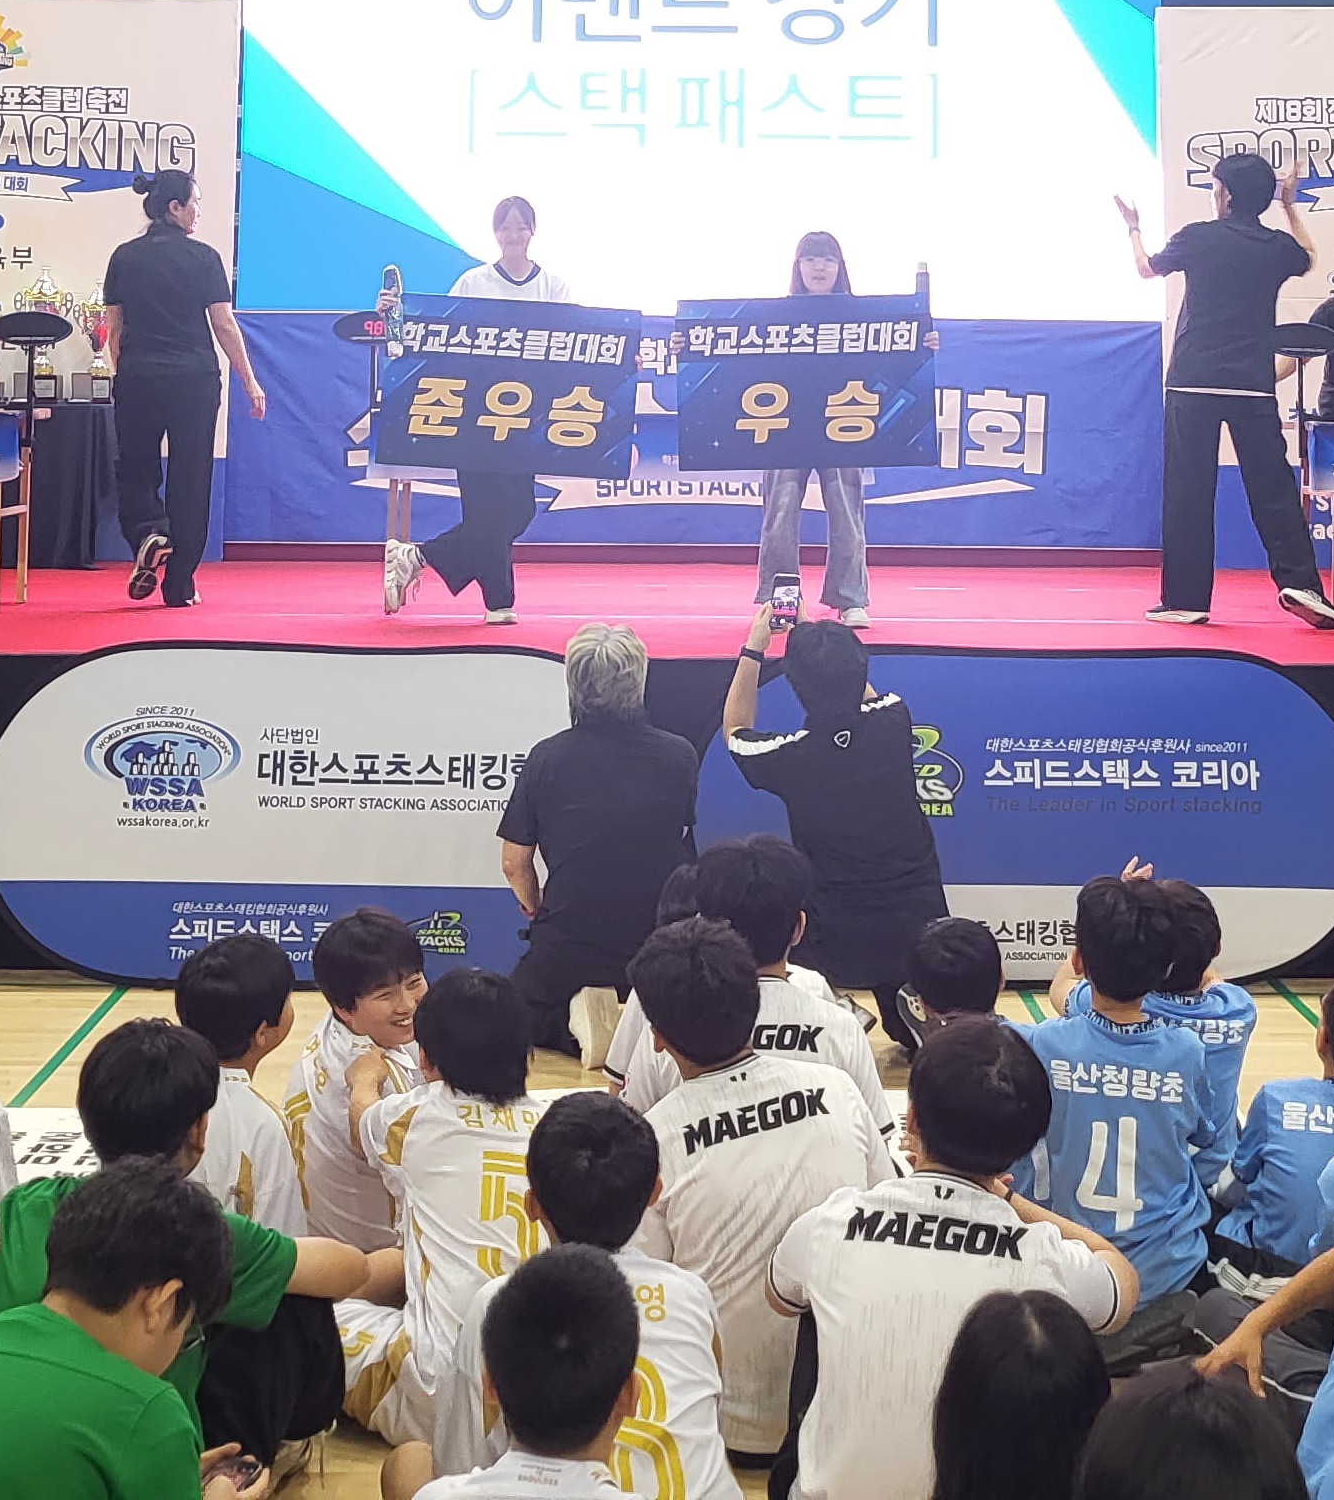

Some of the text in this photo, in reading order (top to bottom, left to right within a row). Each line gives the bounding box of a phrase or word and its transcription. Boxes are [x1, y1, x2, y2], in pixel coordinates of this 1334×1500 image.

[86, 86, 129, 115] 축전
[1254, 98, 1322, 125] 제18회
[3, 175, 29, 193] 대회
[401, 320, 626, 366] 학교스포츠클럽대회
[688, 321, 919, 357] 학교스포츠클럽대회
[407, 376, 605, 448] 준우승
[136, 705, 195, 717] SINCE 2011
[259, 727, 319, 745] 사단법인
[985, 737, 1249, 754] 대한스포츠스태킹협회공식후원사 since2011
[983, 758, 1162, 791] 스피드스택스
[1171, 759, 1261, 791] 코리아
[124, 776, 205, 798] WSSA
[132, 797, 198, 813] KOREA
[257, 795, 306, 809] WORLD
[310, 795, 356, 810] SPORT
[358, 797, 427, 811] STACKING
[986, 796, 1021, 812] The
[1027, 796, 1092, 812] Leader
[1124, 795, 1177, 815] Sport
[1182, 797, 1263, 816] stacking
[116, 815, 210, 828] wssakorea.or.kr
[171, 901, 329, 917] 대한스포츠스태킹협회공식후원사
[1005, 951, 1068, 961] ASSOCIATION
[753, 1023, 825, 1053] GOK
[1050, 1059, 1185, 1104] 울산청량초
[682, 1087, 831, 1156] MAEGOK
[1075, 1116, 1145, 1233] 4
[843, 1206, 1029, 1261] MAEGOK
